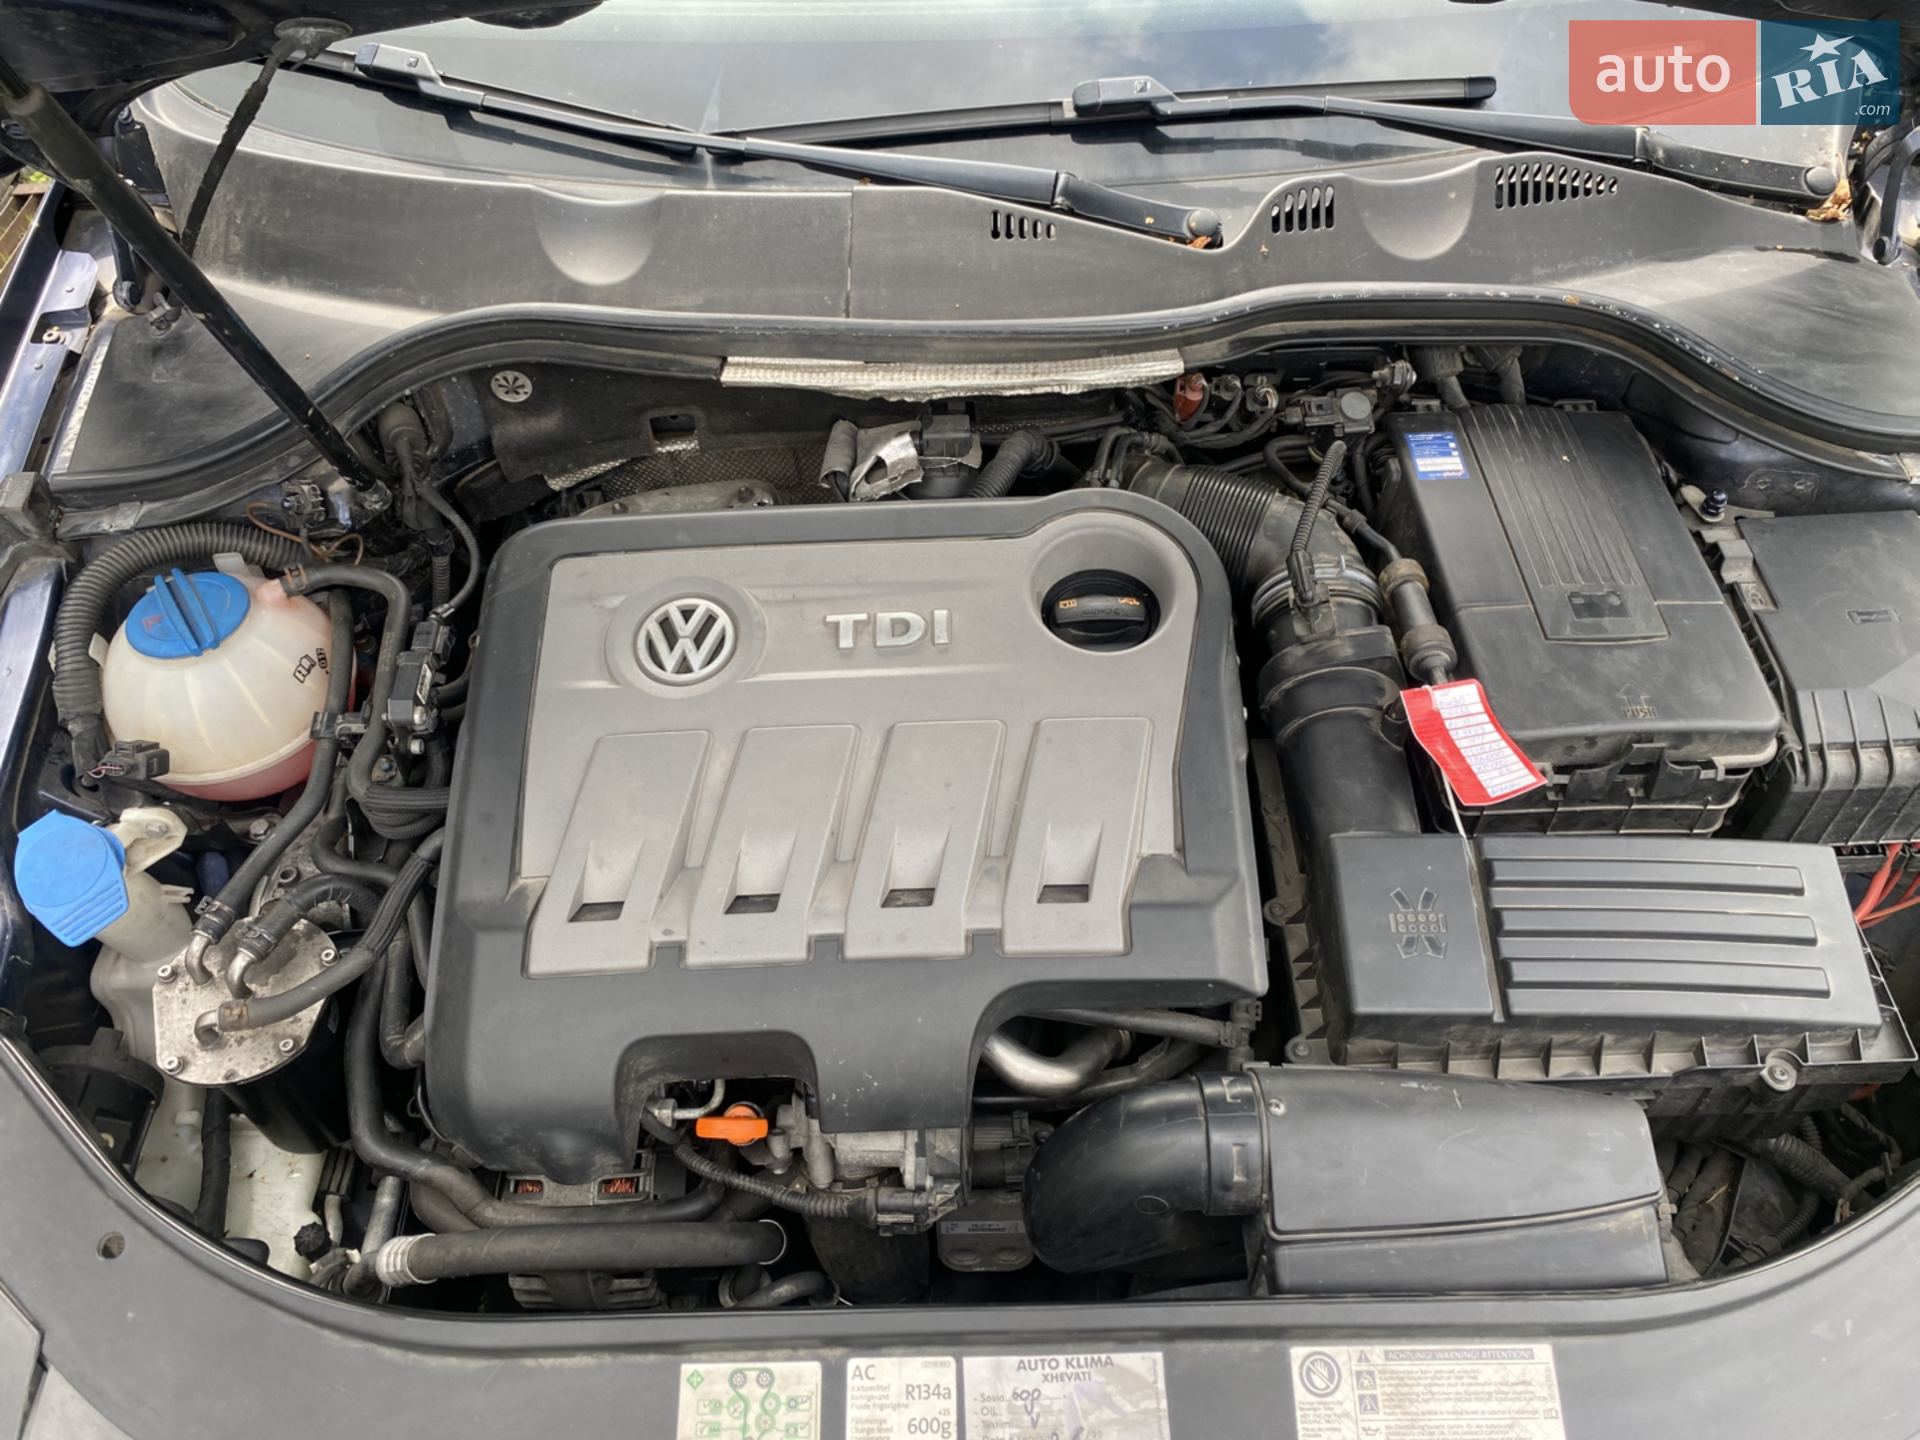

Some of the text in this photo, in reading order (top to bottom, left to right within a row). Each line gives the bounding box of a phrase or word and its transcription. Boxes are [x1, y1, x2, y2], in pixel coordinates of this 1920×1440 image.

[825, 608, 949, 650] TDI
[1621, 706, 1658, 719] PUSH
[1480, 1348, 1532, 1358] ATTENTION!
[1016, 1355, 1114, 1372] AUTO KLIMA
[851, 1364, 876, 1381] AC
[1041, 1371, 1092, 1384] XHEVATI
[905, 1383, 952, 1401] R134a
[907, 1417, 952, 1440] 600g
